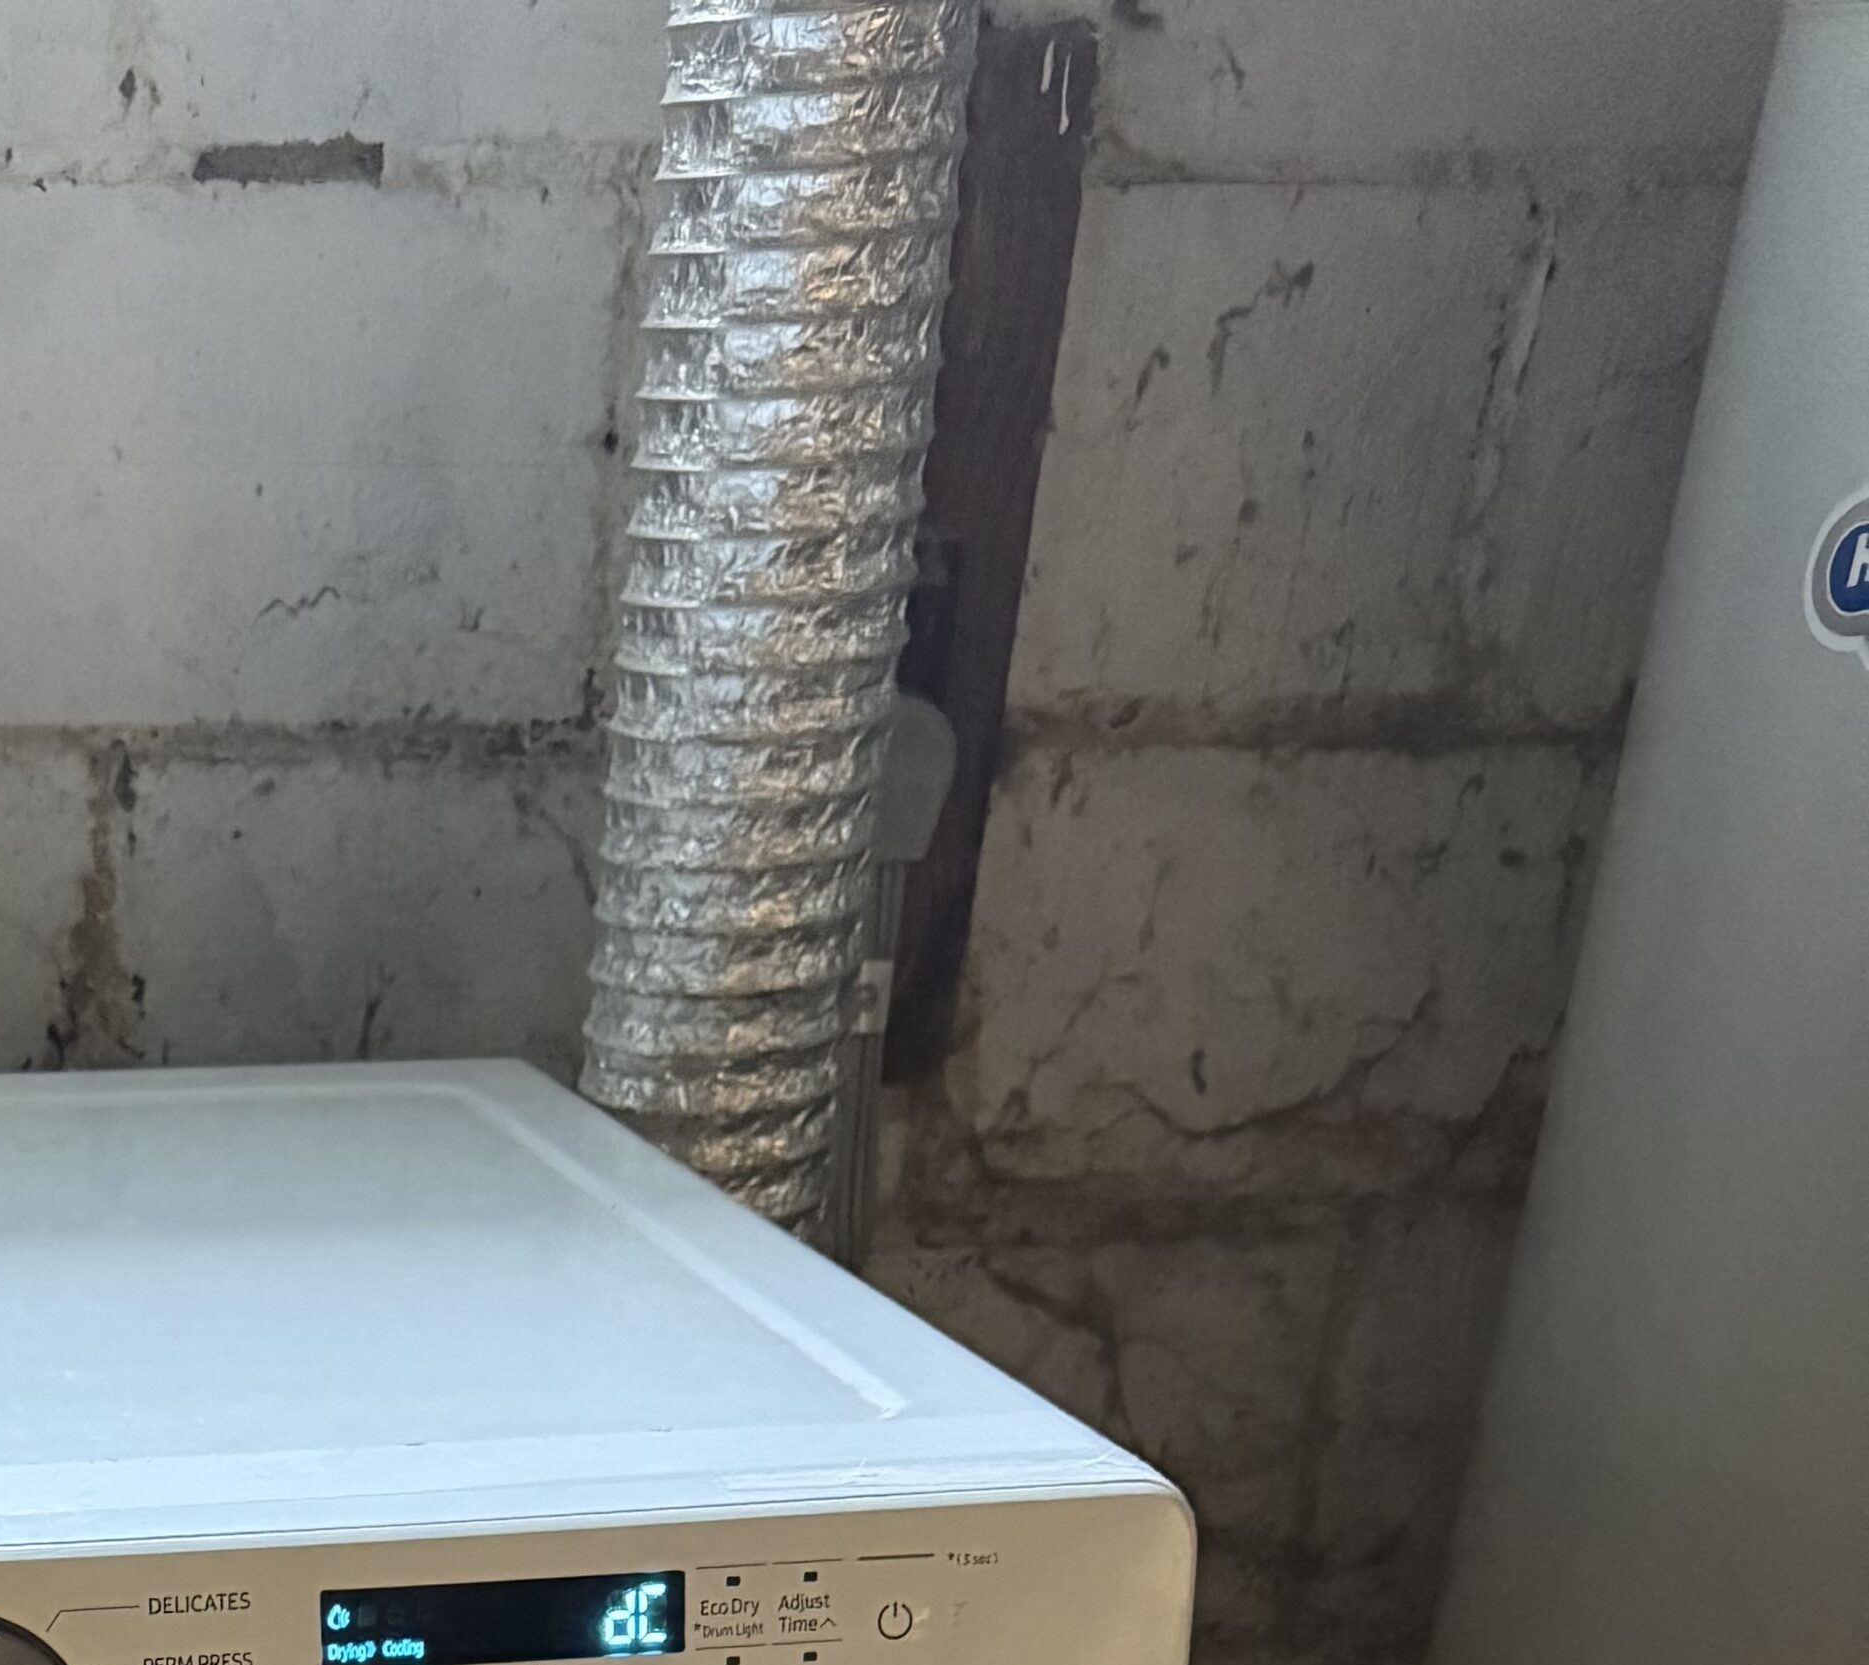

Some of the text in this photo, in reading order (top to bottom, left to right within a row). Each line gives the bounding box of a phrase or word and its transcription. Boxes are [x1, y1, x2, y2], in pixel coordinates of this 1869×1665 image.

[149, 1592, 250, 1615] DELICATES
[778, 1594, 830, 1612] Adjust
[736, 1623, 763, 1638] Light
[779, 1616, 817, 1632] Time
